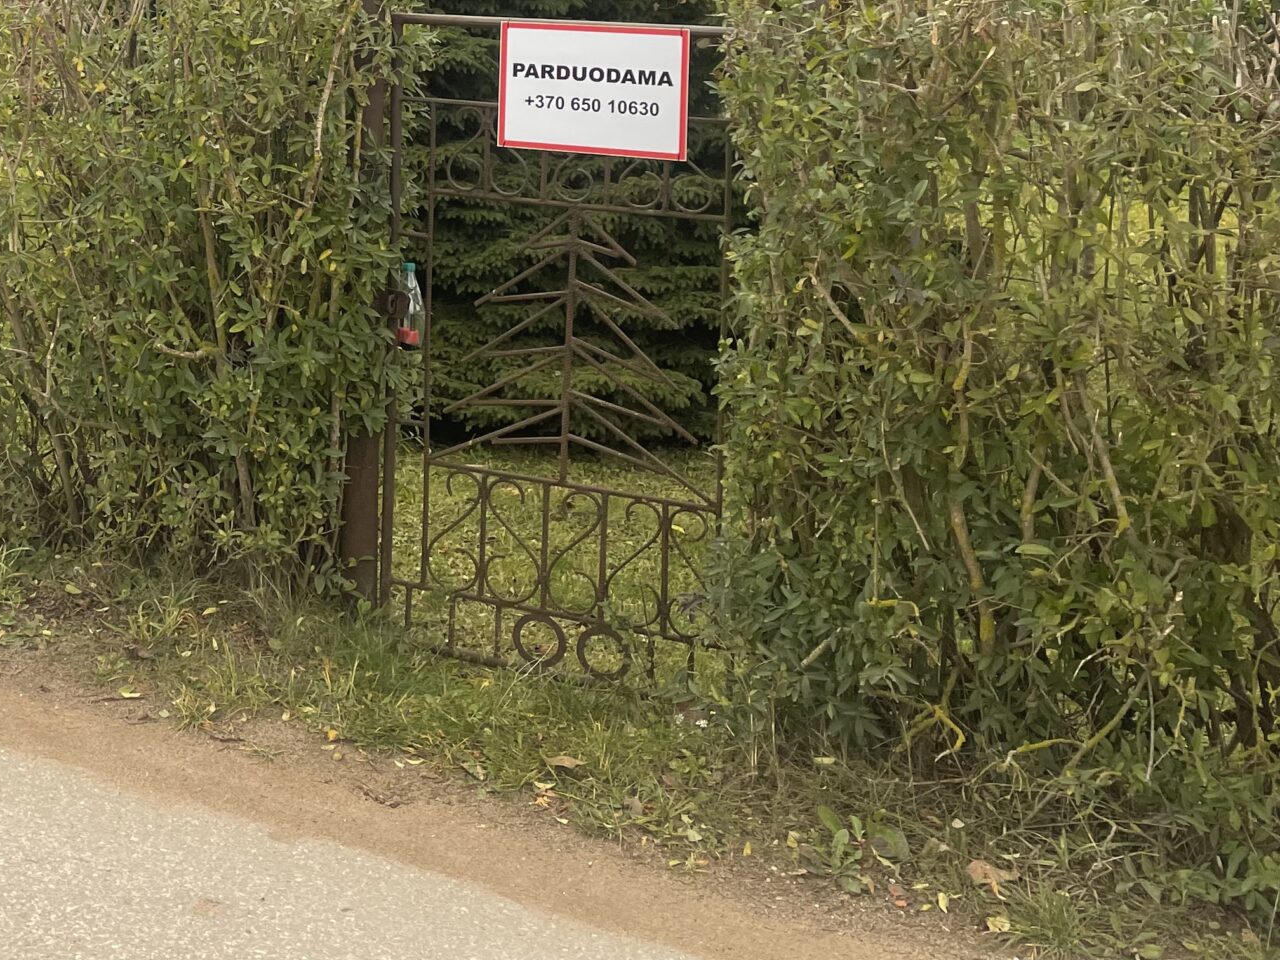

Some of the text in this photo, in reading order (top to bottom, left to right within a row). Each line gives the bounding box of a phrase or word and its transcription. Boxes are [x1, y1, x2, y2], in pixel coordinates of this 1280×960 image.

[512, 62, 674, 87] PARDUODAMA
[524, 94, 660, 117] +370 650 10630
